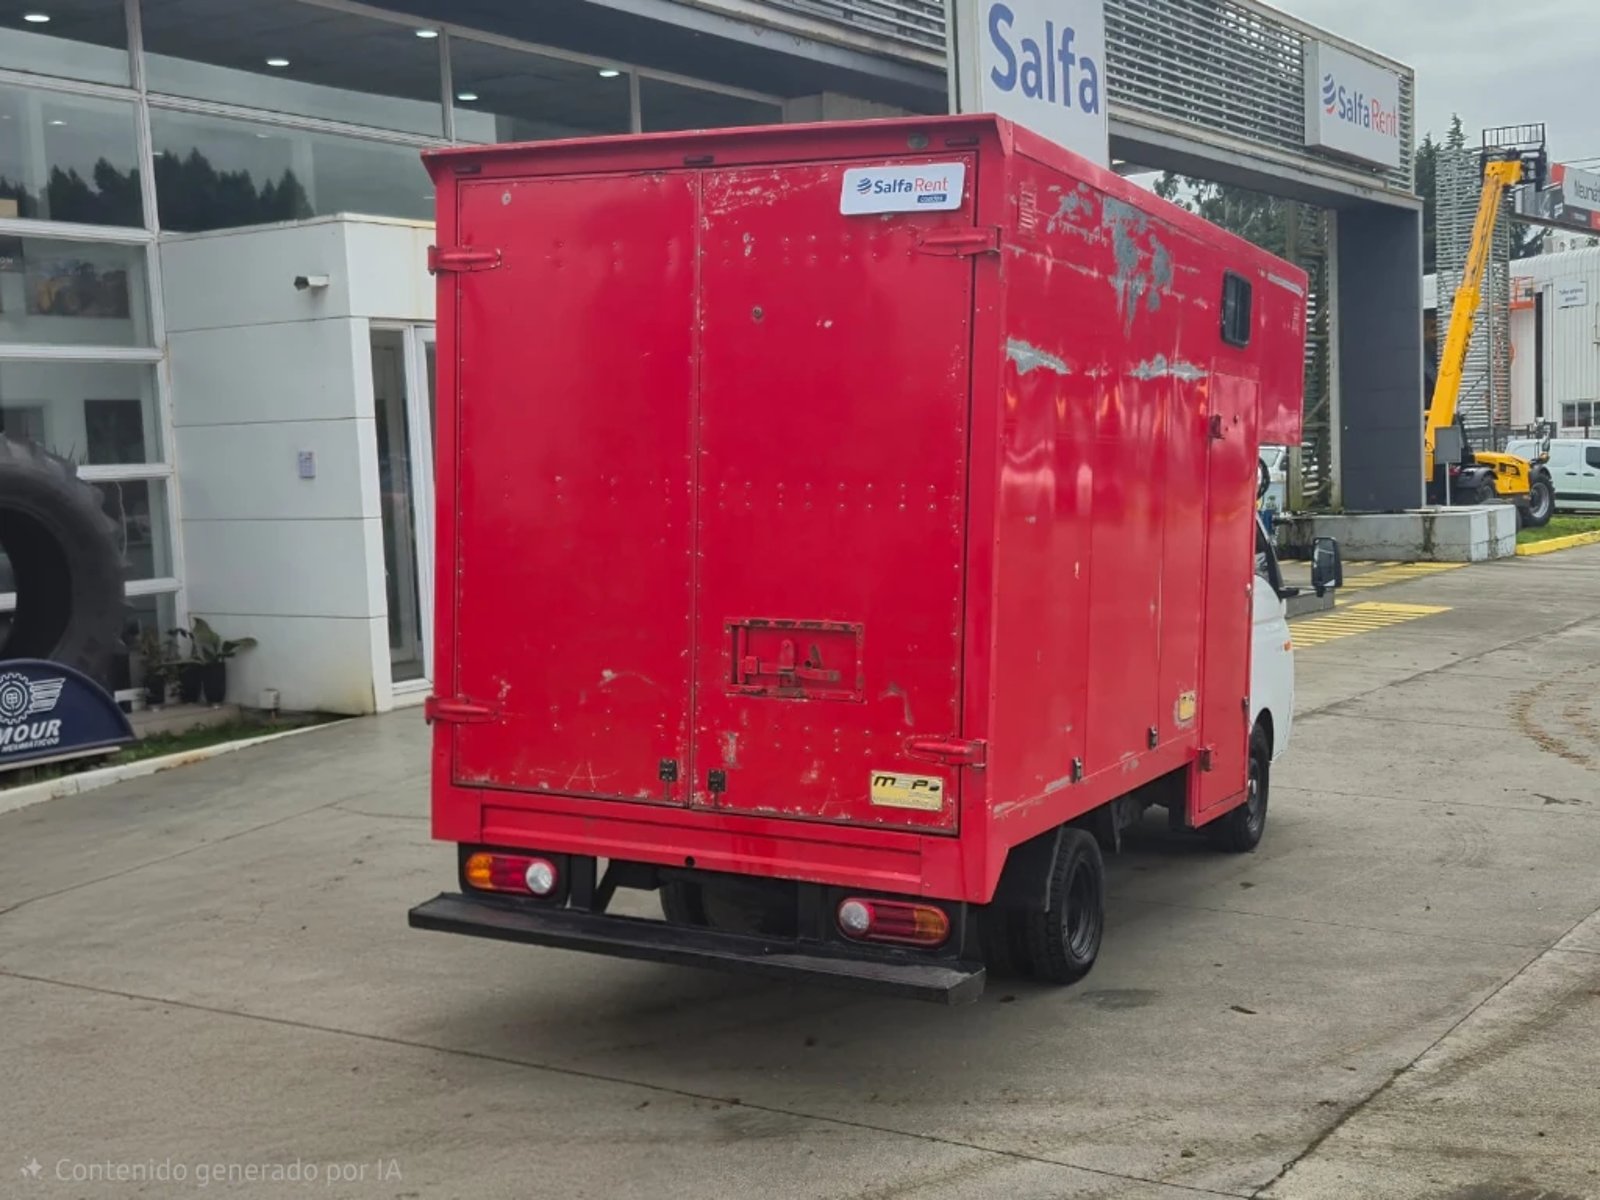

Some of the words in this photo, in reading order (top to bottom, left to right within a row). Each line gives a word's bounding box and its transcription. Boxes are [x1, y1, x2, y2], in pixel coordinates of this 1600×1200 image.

[988, 2, 1099, 115] Salfa
[1338, 85, 1398, 138] SalfaRent
[873, 177, 948, 194] SalfaRent
